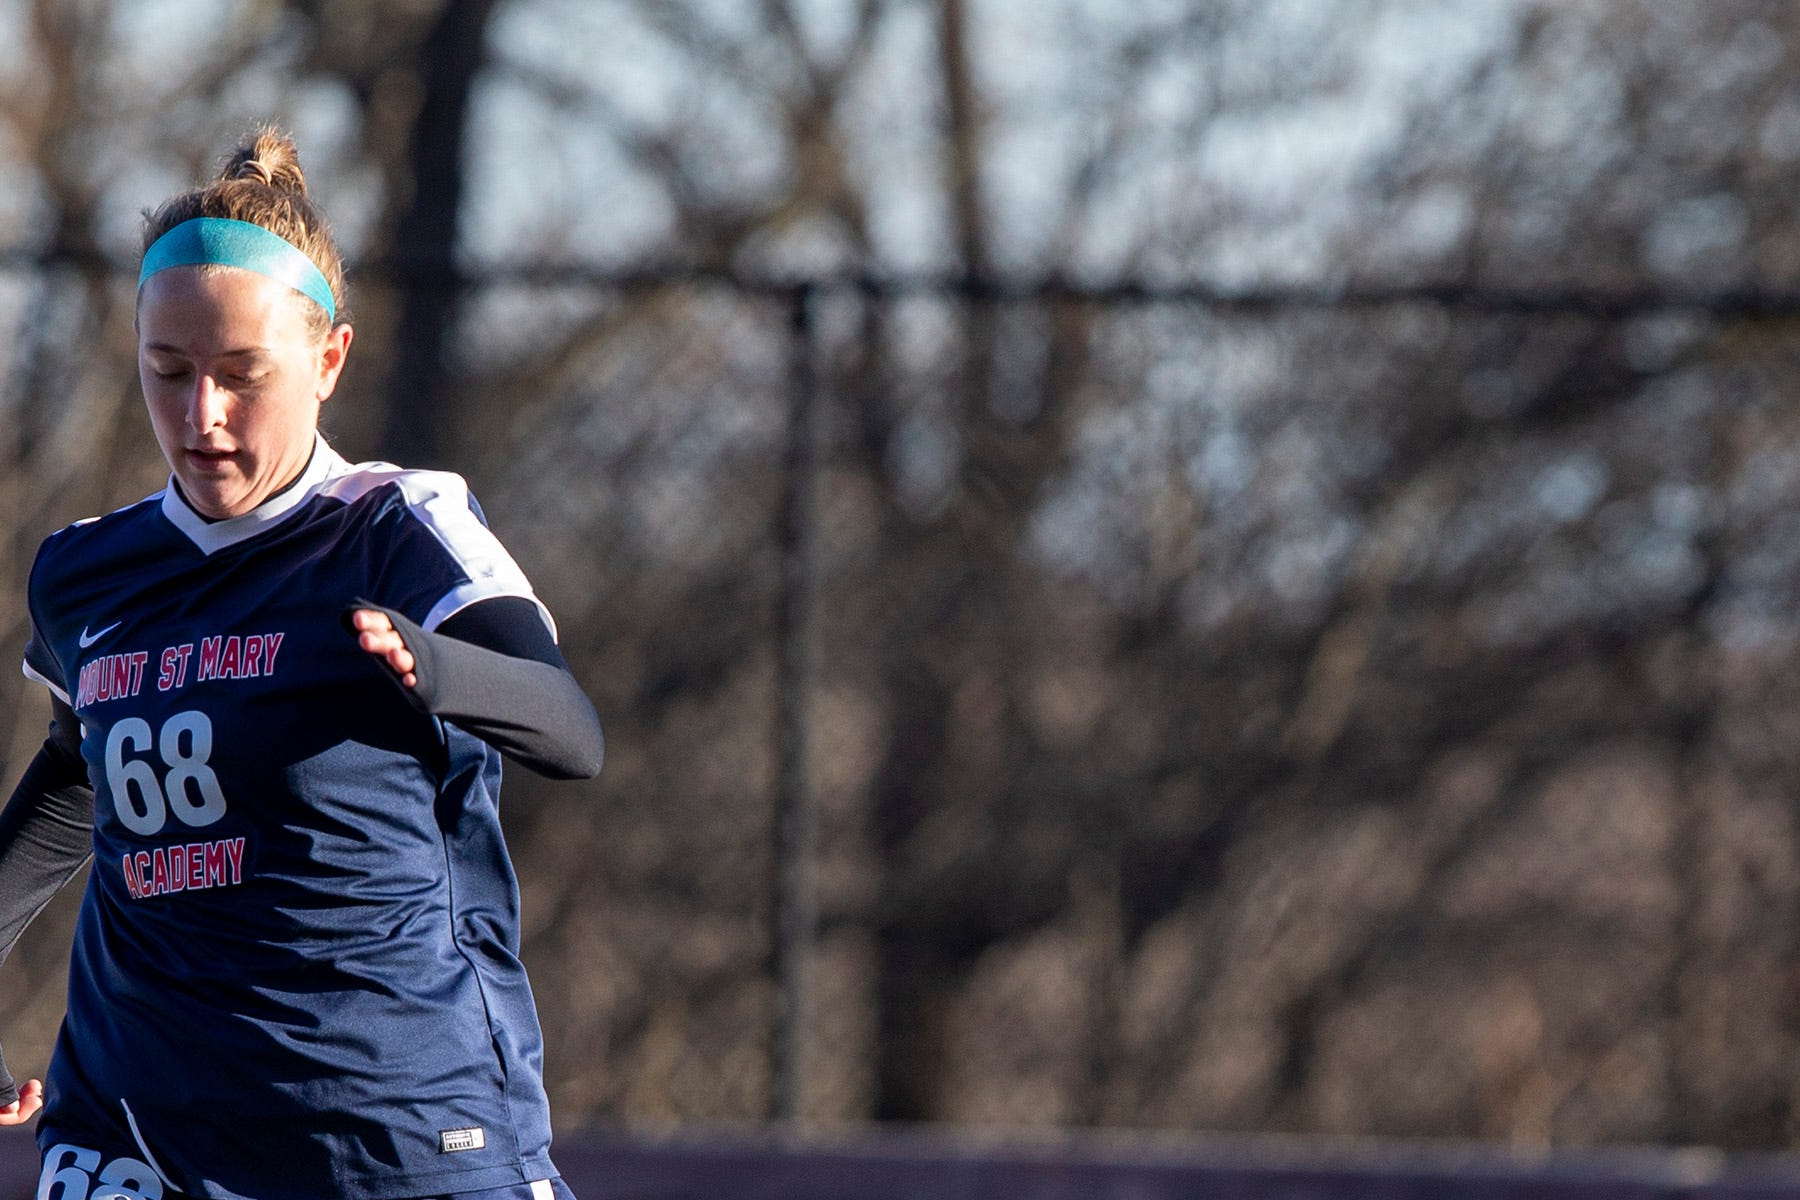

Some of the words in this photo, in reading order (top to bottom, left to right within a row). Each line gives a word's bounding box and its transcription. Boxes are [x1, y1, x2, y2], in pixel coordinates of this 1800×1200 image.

[75, 651, 148, 711] MOUNT
[157, 644, 193, 692] ST
[197, 632, 285, 682] MARY
[104, 709, 227, 836] 68
[122, 837, 246, 900] ACADEMY
